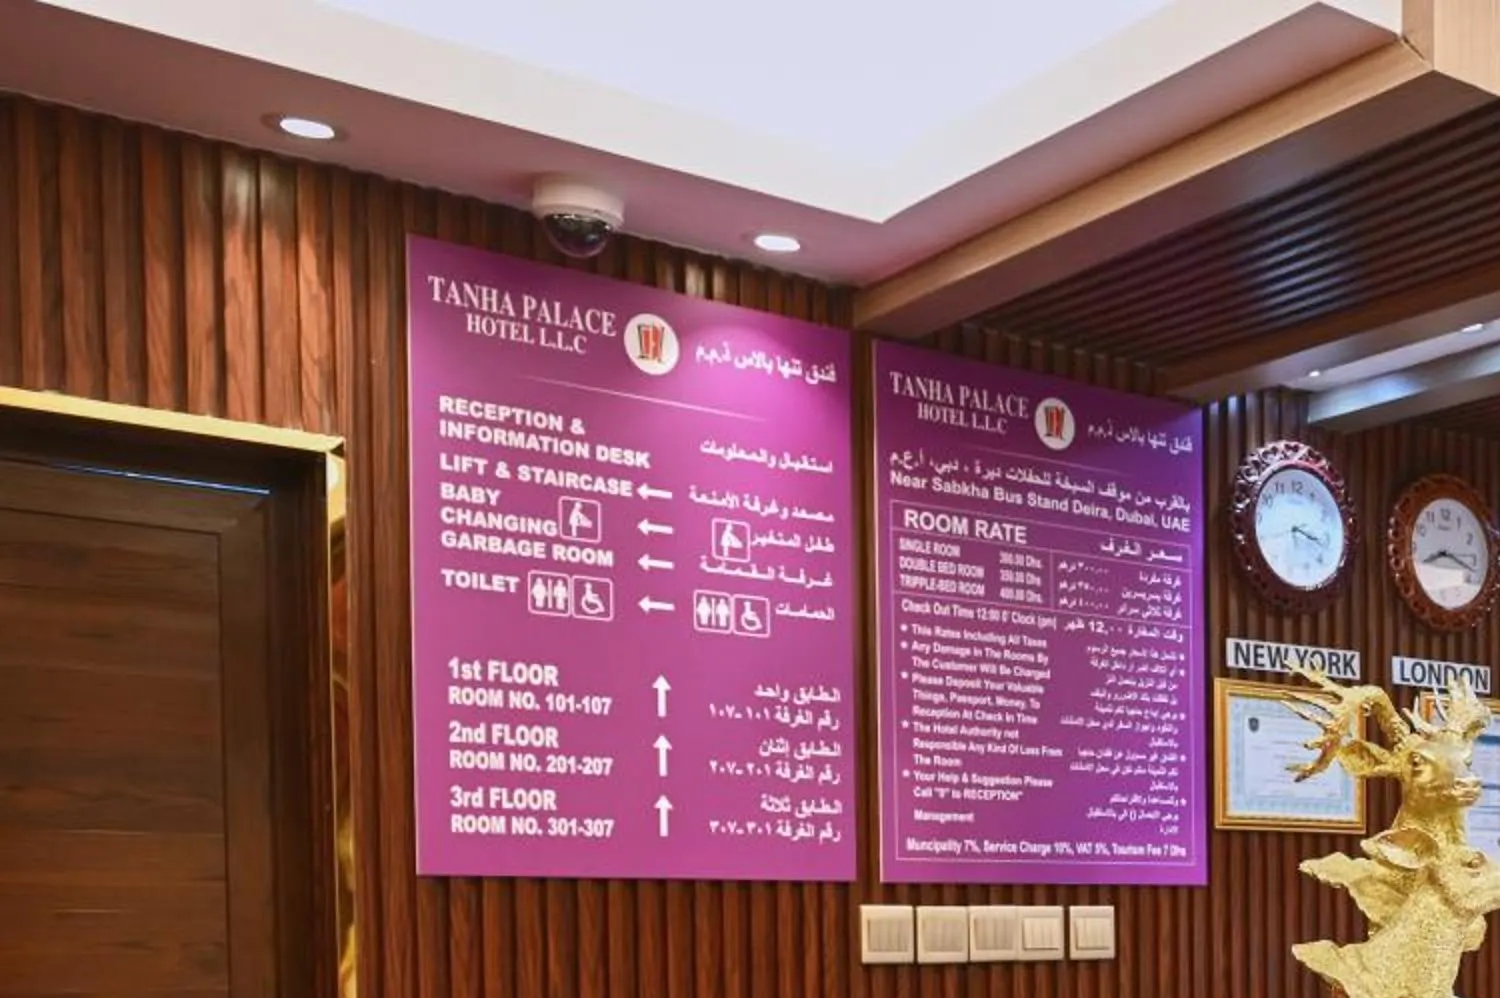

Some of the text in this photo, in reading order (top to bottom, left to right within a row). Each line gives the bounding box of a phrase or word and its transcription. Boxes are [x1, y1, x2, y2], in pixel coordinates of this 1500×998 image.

[428, 276, 617, 337] TANHA PALACE
[466, 313, 535, 344] HOTEL
[805, 363, 837, 384] فندق
[890, 371, 1029, 419] TANHA PALACE
[439, 395, 585, 435] RECEPTION &
[917, 402, 969, 427] HOTEL
[439, 419, 651, 469] INFORMATION DESK
[440, 452, 633, 497] LIFT & STAIRCASE
[440, 482, 501, 506] BABY
[890, 470, 927, 489] Near
[932, 477, 989, 499] Sabkha
[994, 487, 1023, 505] Bus
[1028, 491, 1069, 513] Stand
[1161, 518, 1191, 533] UAE
[440, 506, 558, 537] CHANGING
[904, 508, 1028, 545] ROOM RATE
[441, 530, 614, 568] GARBAGE ROOM
[933, 541, 961, 557] ROOM
[441, 568, 520, 593] TOILET
[958, 564, 985, 578] ROOM
[958, 580, 985, 597] ROOM
[901, 599, 1035, 625] Check Out Time Clock
[911, 623, 932, 637] This
[963, 629, 1006, 646] Including
[1008, 634, 1021, 645] All
[911, 640, 931, 655] Any
[933, 642, 971, 658] Damage
[985, 647, 1001, 660] The
[1003, 649, 1035, 663] Rooms
[1233, 641, 1357, 677] NEW YORK
[448, 656, 559, 687] 1st FLOOR
[911, 672, 944, 686] Please
[945, 675, 982, 690] Deposit
[912, 656, 930, 670] The
[932, 658, 978, 673] Customer
[1013, 666, 1051, 681] Charged
[1399, 659, 1489, 691] LONDON
[448, 685, 613, 716] ROOM NO. 101-107
[817, 709, 840, 732] رقم
[912, 705, 961, 721] Reception
[974, 710, 1004, 722] Check
[1017, 713, 1038, 725] Time
[449, 720, 559, 749] 2nd FLOOR
[913, 721, 931, 733] The
[959, 724, 1001, 740] Authority
[913, 754, 931, 766] The
[968, 741, 986, 755] Any
[449, 749, 614, 776] ROOM NO. 201-207
[818, 764, 841, 786] رقم
[450, 784, 557, 811] 3rd FLOOR
[913, 785, 933, 798] Call
[451, 814, 615, 838] ROOM NO. 301-307
[913, 809, 975, 824] Management
[819, 821, 842, 845] رقم
[983, 840, 1018, 853] Service
[1019, 841, 1051, 857] Charge
